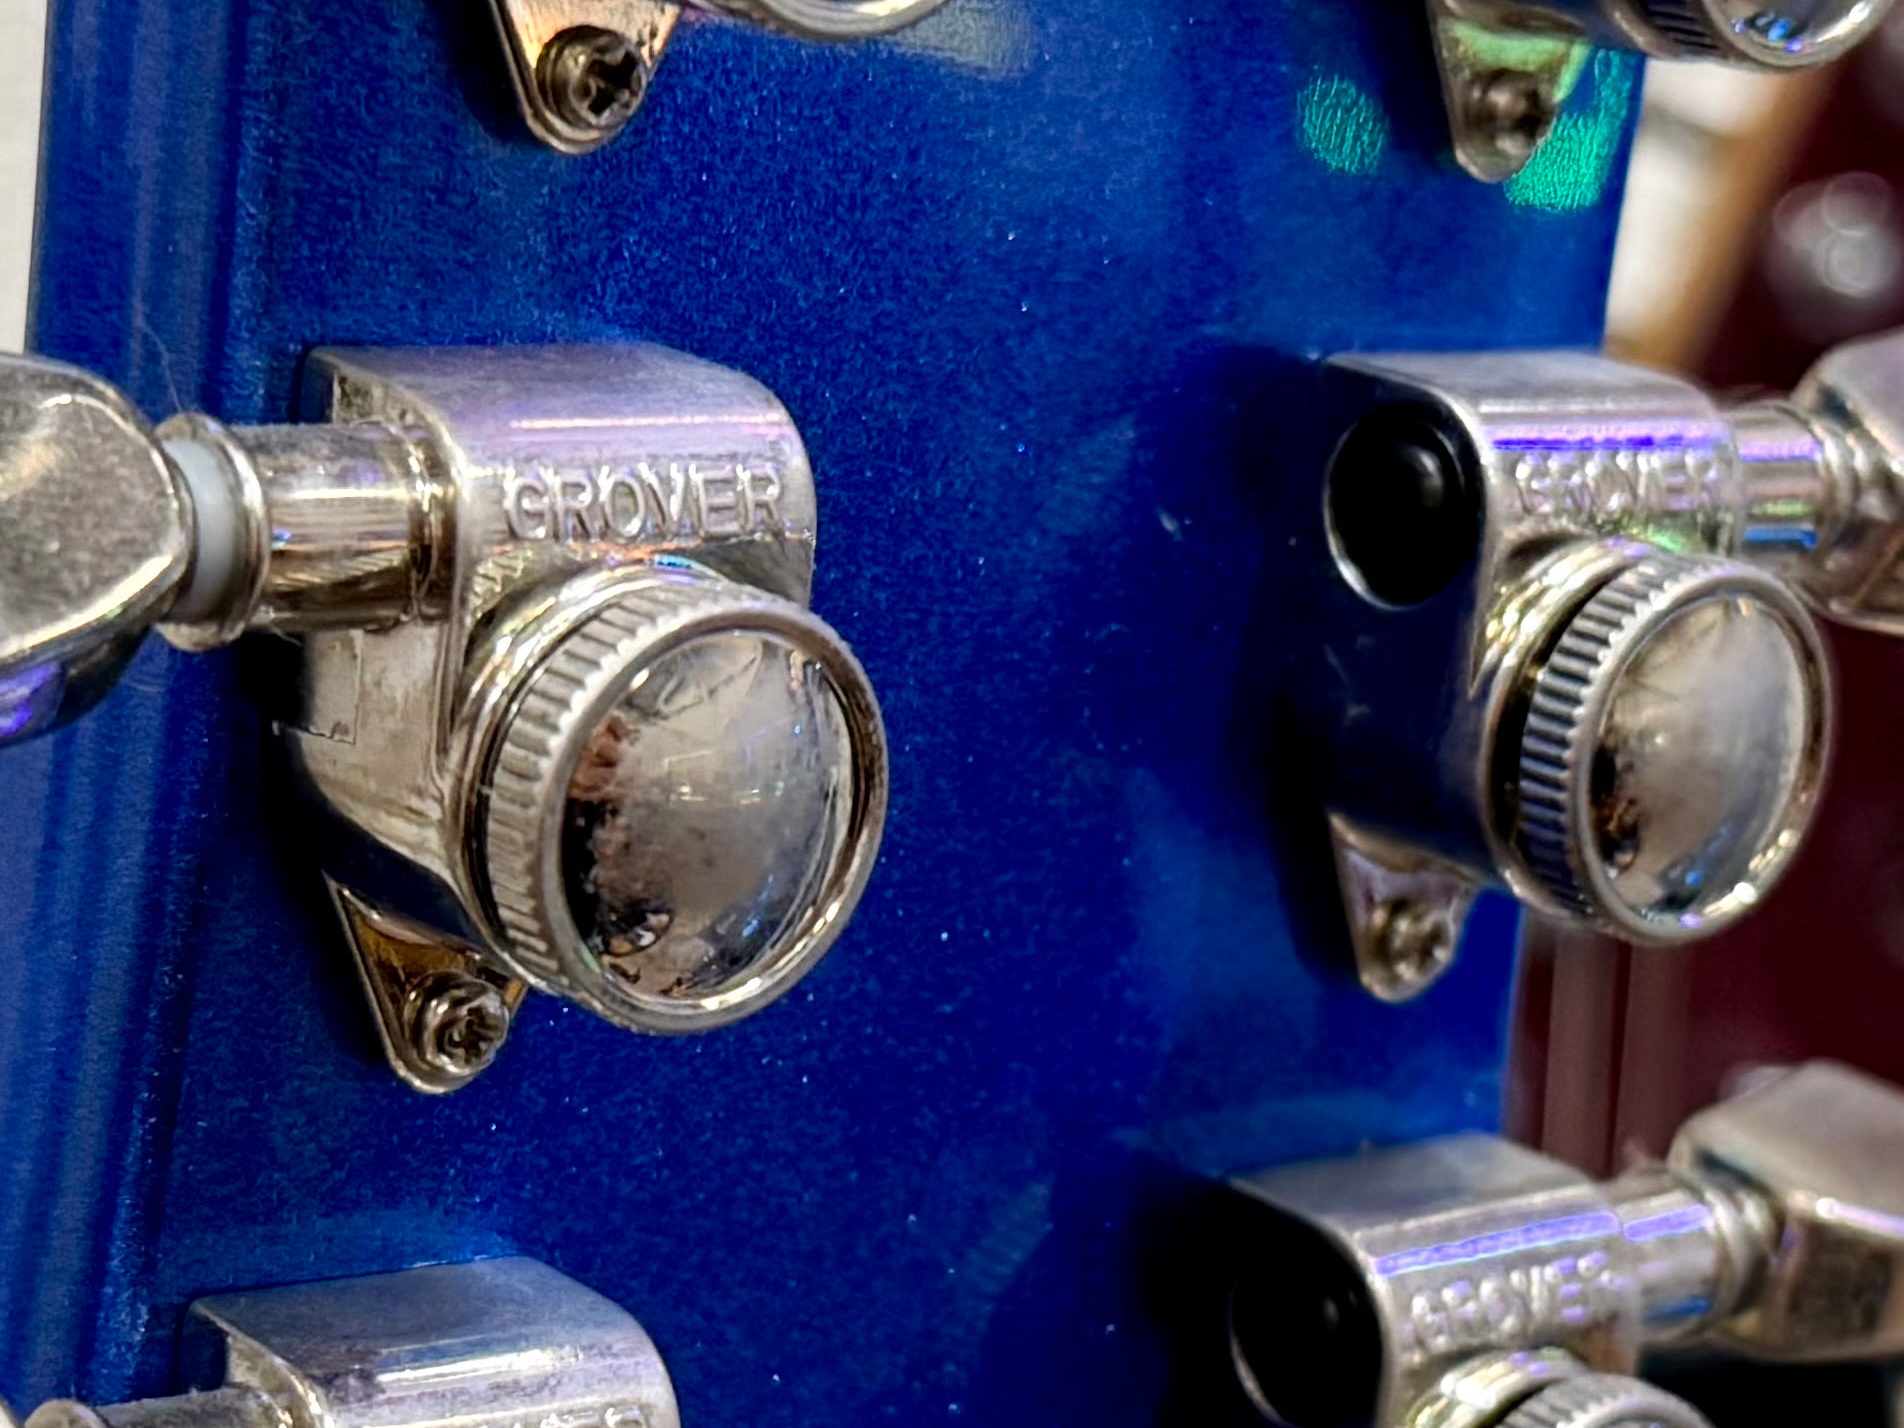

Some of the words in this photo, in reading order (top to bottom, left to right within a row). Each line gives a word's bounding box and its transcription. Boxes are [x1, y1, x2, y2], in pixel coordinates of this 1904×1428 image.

[503, 460, 788, 540] GROVER
[1516, 450, 1722, 522] GROVER
[1410, 1250, 1628, 1348] GROVER
